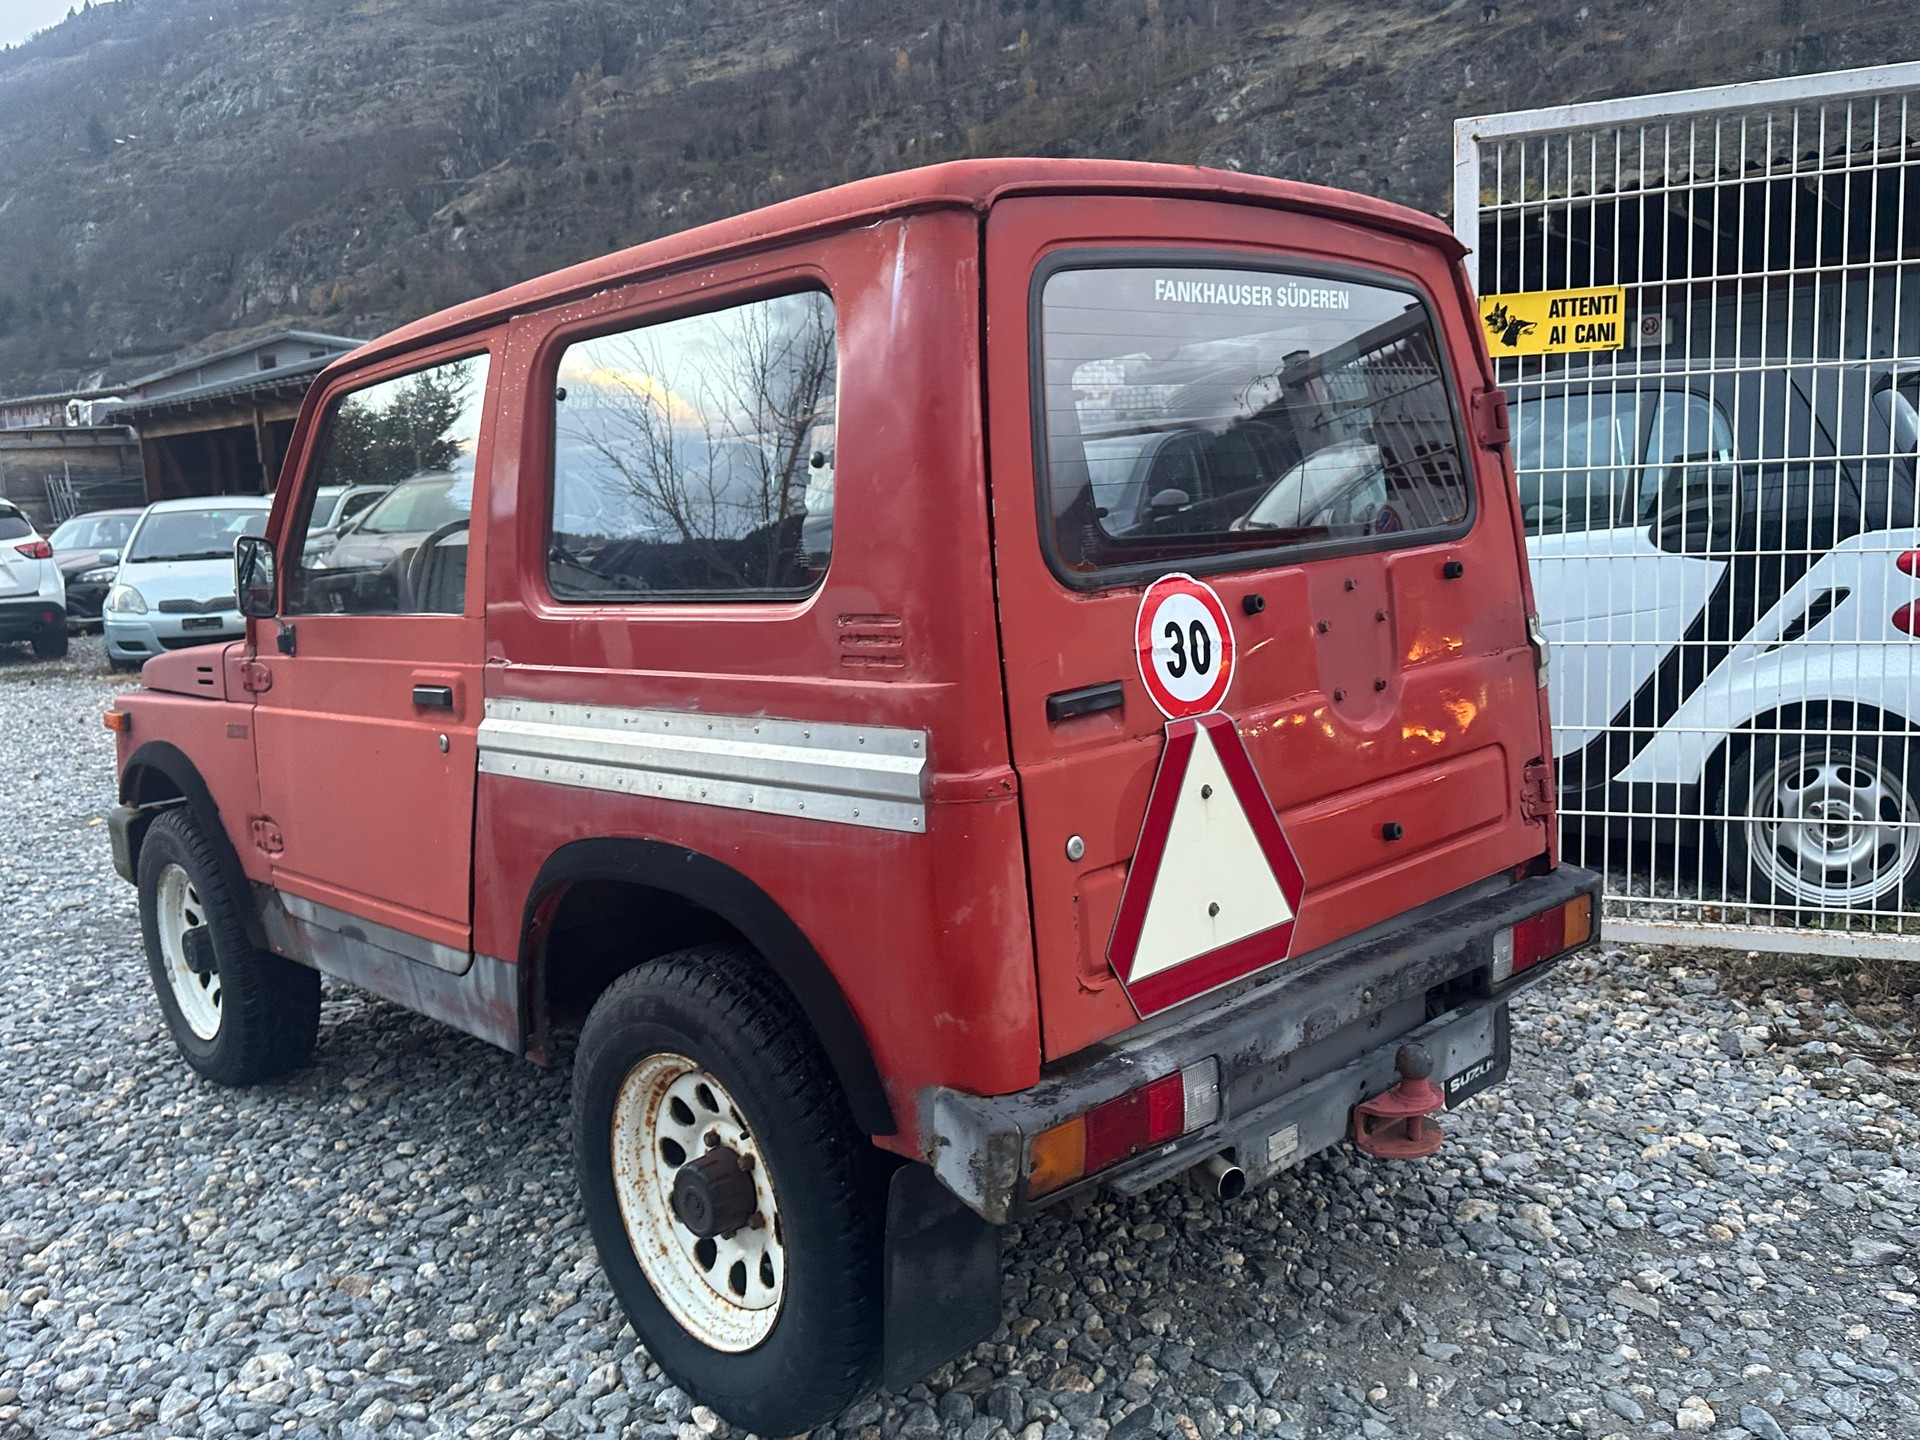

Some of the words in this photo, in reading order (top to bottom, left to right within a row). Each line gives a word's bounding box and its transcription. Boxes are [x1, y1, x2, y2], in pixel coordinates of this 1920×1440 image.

[1155, 279, 1272, 306] FANKHAUSER
[1277, 282, 1349, 309] SÜDEREN
[1549, 294, 1618, 318] ATTENTI
[1549, 325, 1566, 345] AI
[1575, 322, 1616, 343] CANI
[1164, 619, 1211, 678] 30
